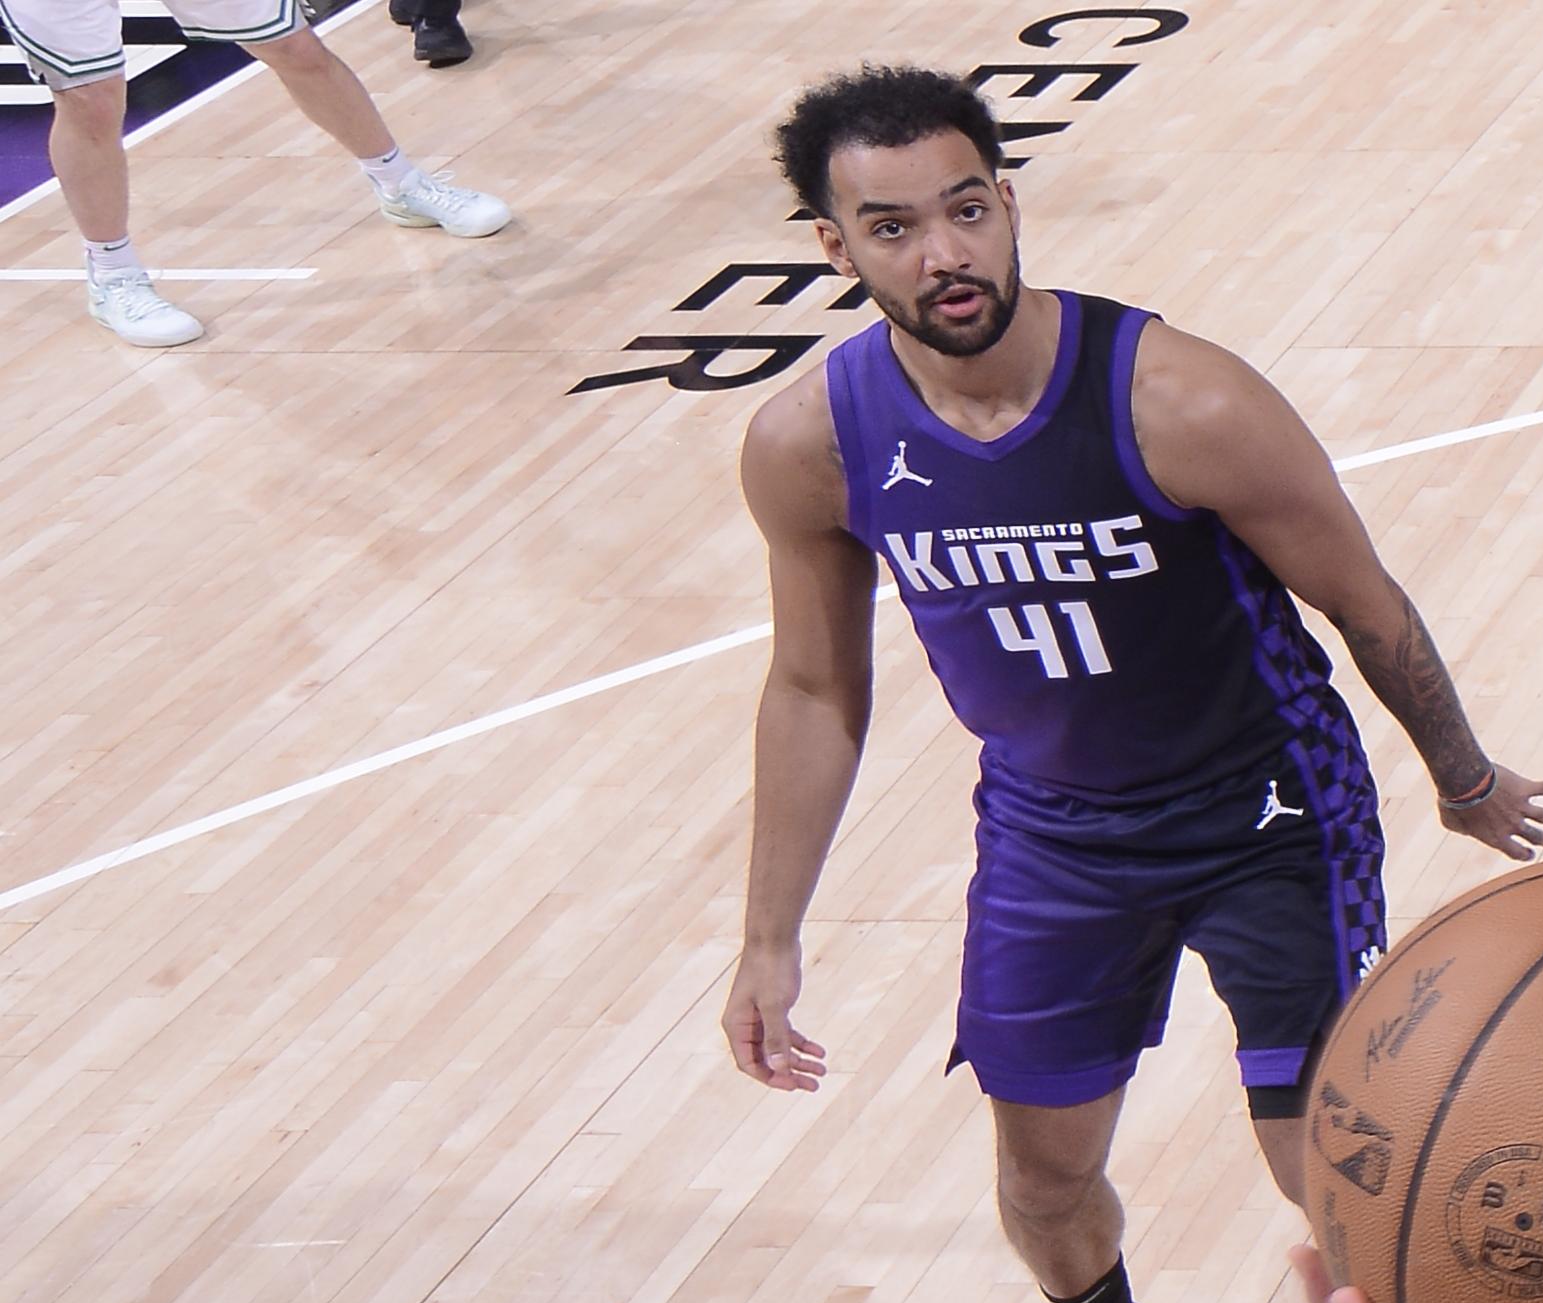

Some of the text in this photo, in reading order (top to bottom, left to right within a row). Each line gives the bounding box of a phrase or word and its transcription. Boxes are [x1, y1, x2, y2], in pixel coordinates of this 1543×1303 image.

[565, 7, 1190, 396] CEER
[884, 514, 1159, 592] KINGS
[941, 523, 1083, 542] SACRAMENTO
[987, 601, 1113, 679] 41
